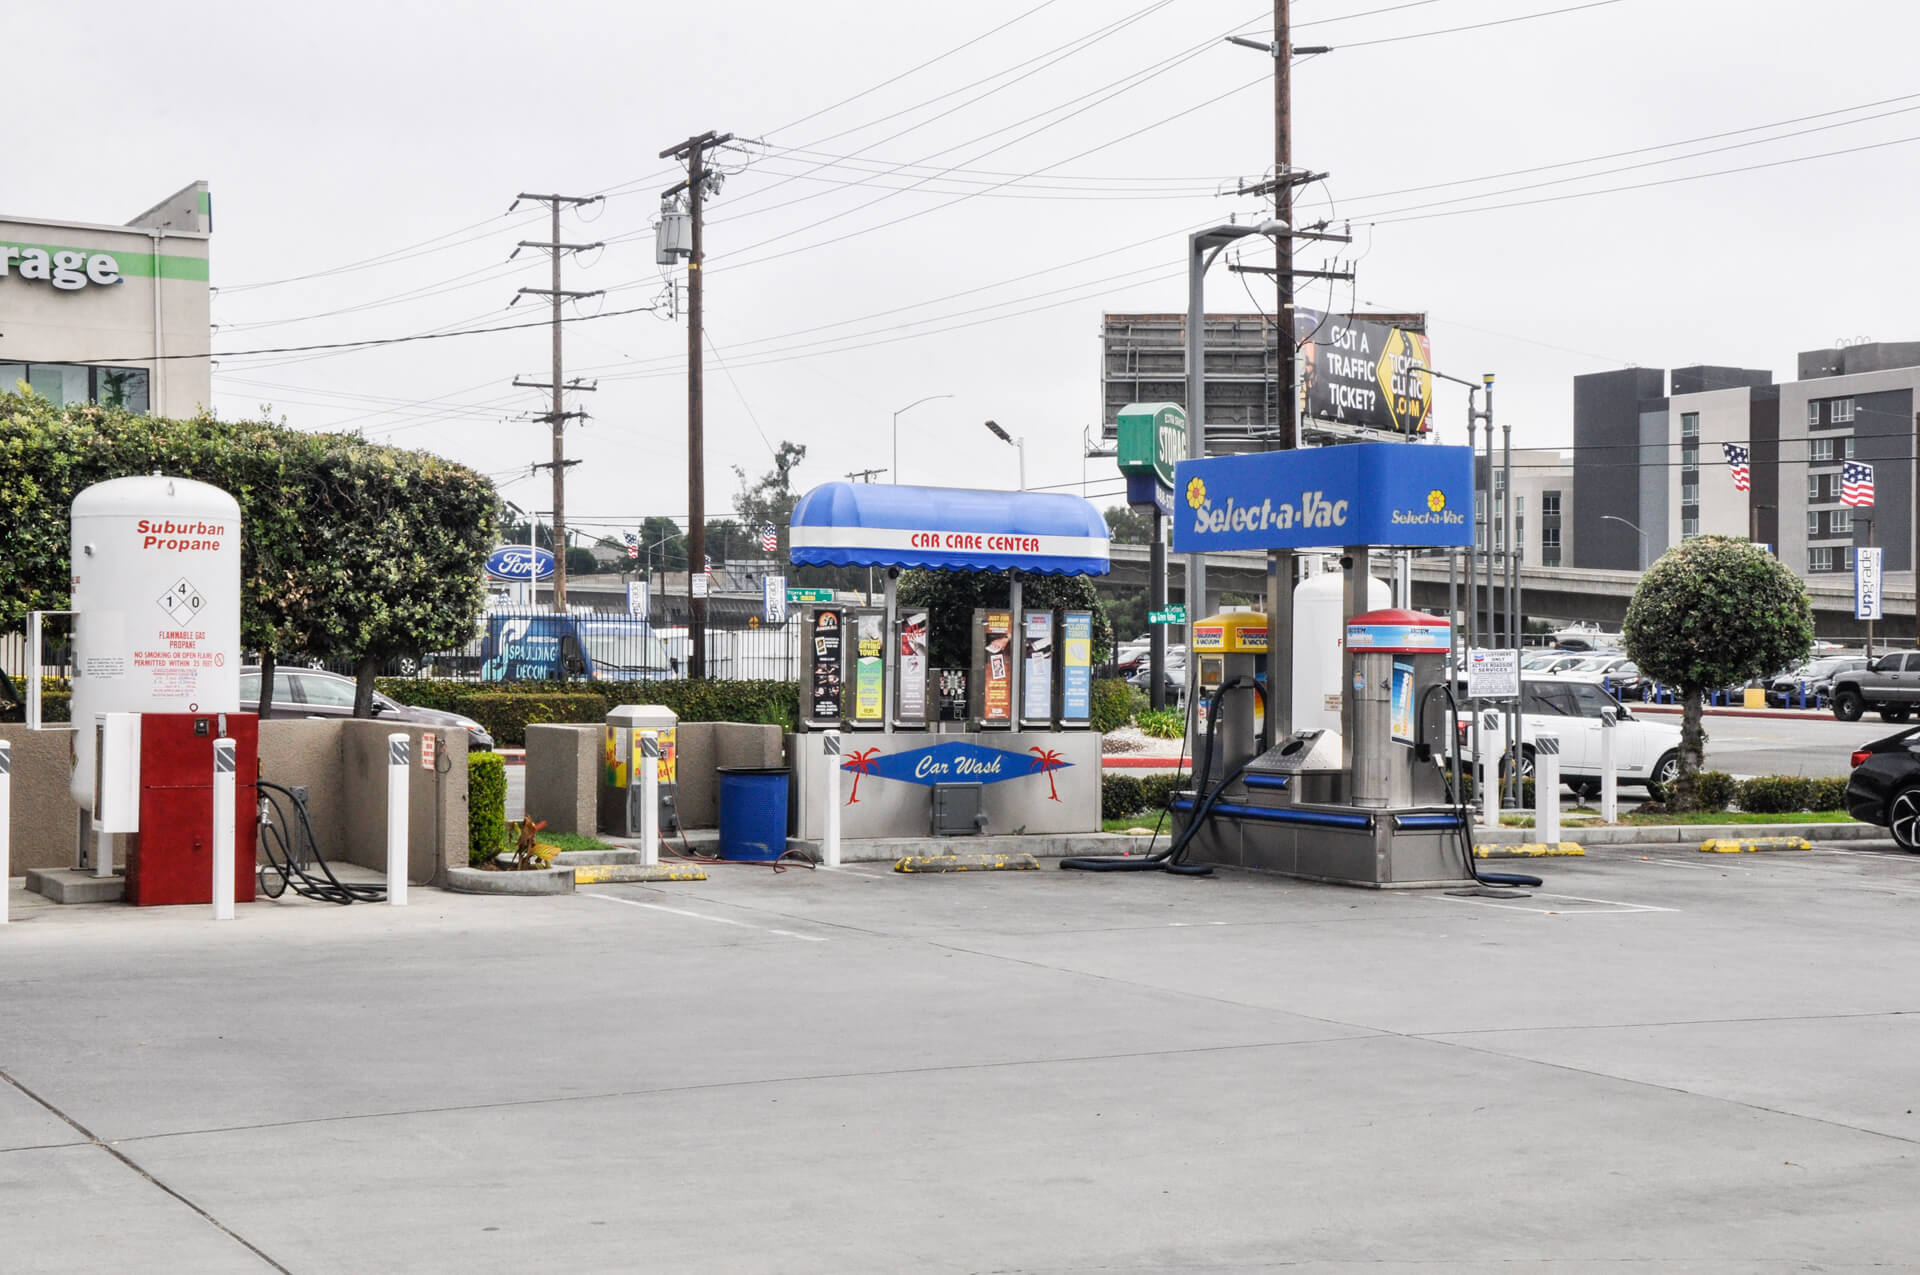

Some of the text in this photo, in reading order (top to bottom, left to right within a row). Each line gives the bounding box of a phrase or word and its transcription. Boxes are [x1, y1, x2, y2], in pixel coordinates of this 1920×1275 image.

[0, 246, 120, 290] rage
[1331, 325, 1369, 353] GOT A
[1327, 352, 1376, 382] TRAFFIC
[1389, 353, 1423, 378] TICKET
[1328, 382, 1376, 412] TICKET?
[1194, 491, 1348, 533] Select-a-Vac
[1391, 510, 1464, 525] Select-a-Vac
[137, 520, 224, 536] Suburban
[143, 535, 220, 552] Propane
[911, 533, 1039, 552] CAR CARE CENTER
[498, 551, 544, 574] Ford
[178, 583, 186, 595] 4
[1859, 550, 1874, 617] Upgrade
[166, 596, 199, 608] 1 0
[158, 631, 206, 640] FLAMMABLE GAS
[169, 640, 197, 649] PROPANE
[144, 651, 171, 659] SMOKING
[860, 649, 880, 657] TOWEL
[134, 659, 166, 667] PERMITTED
[169, 659, 190, 667] WITHIN
[915, 754, 1002, 778] Car Wash
